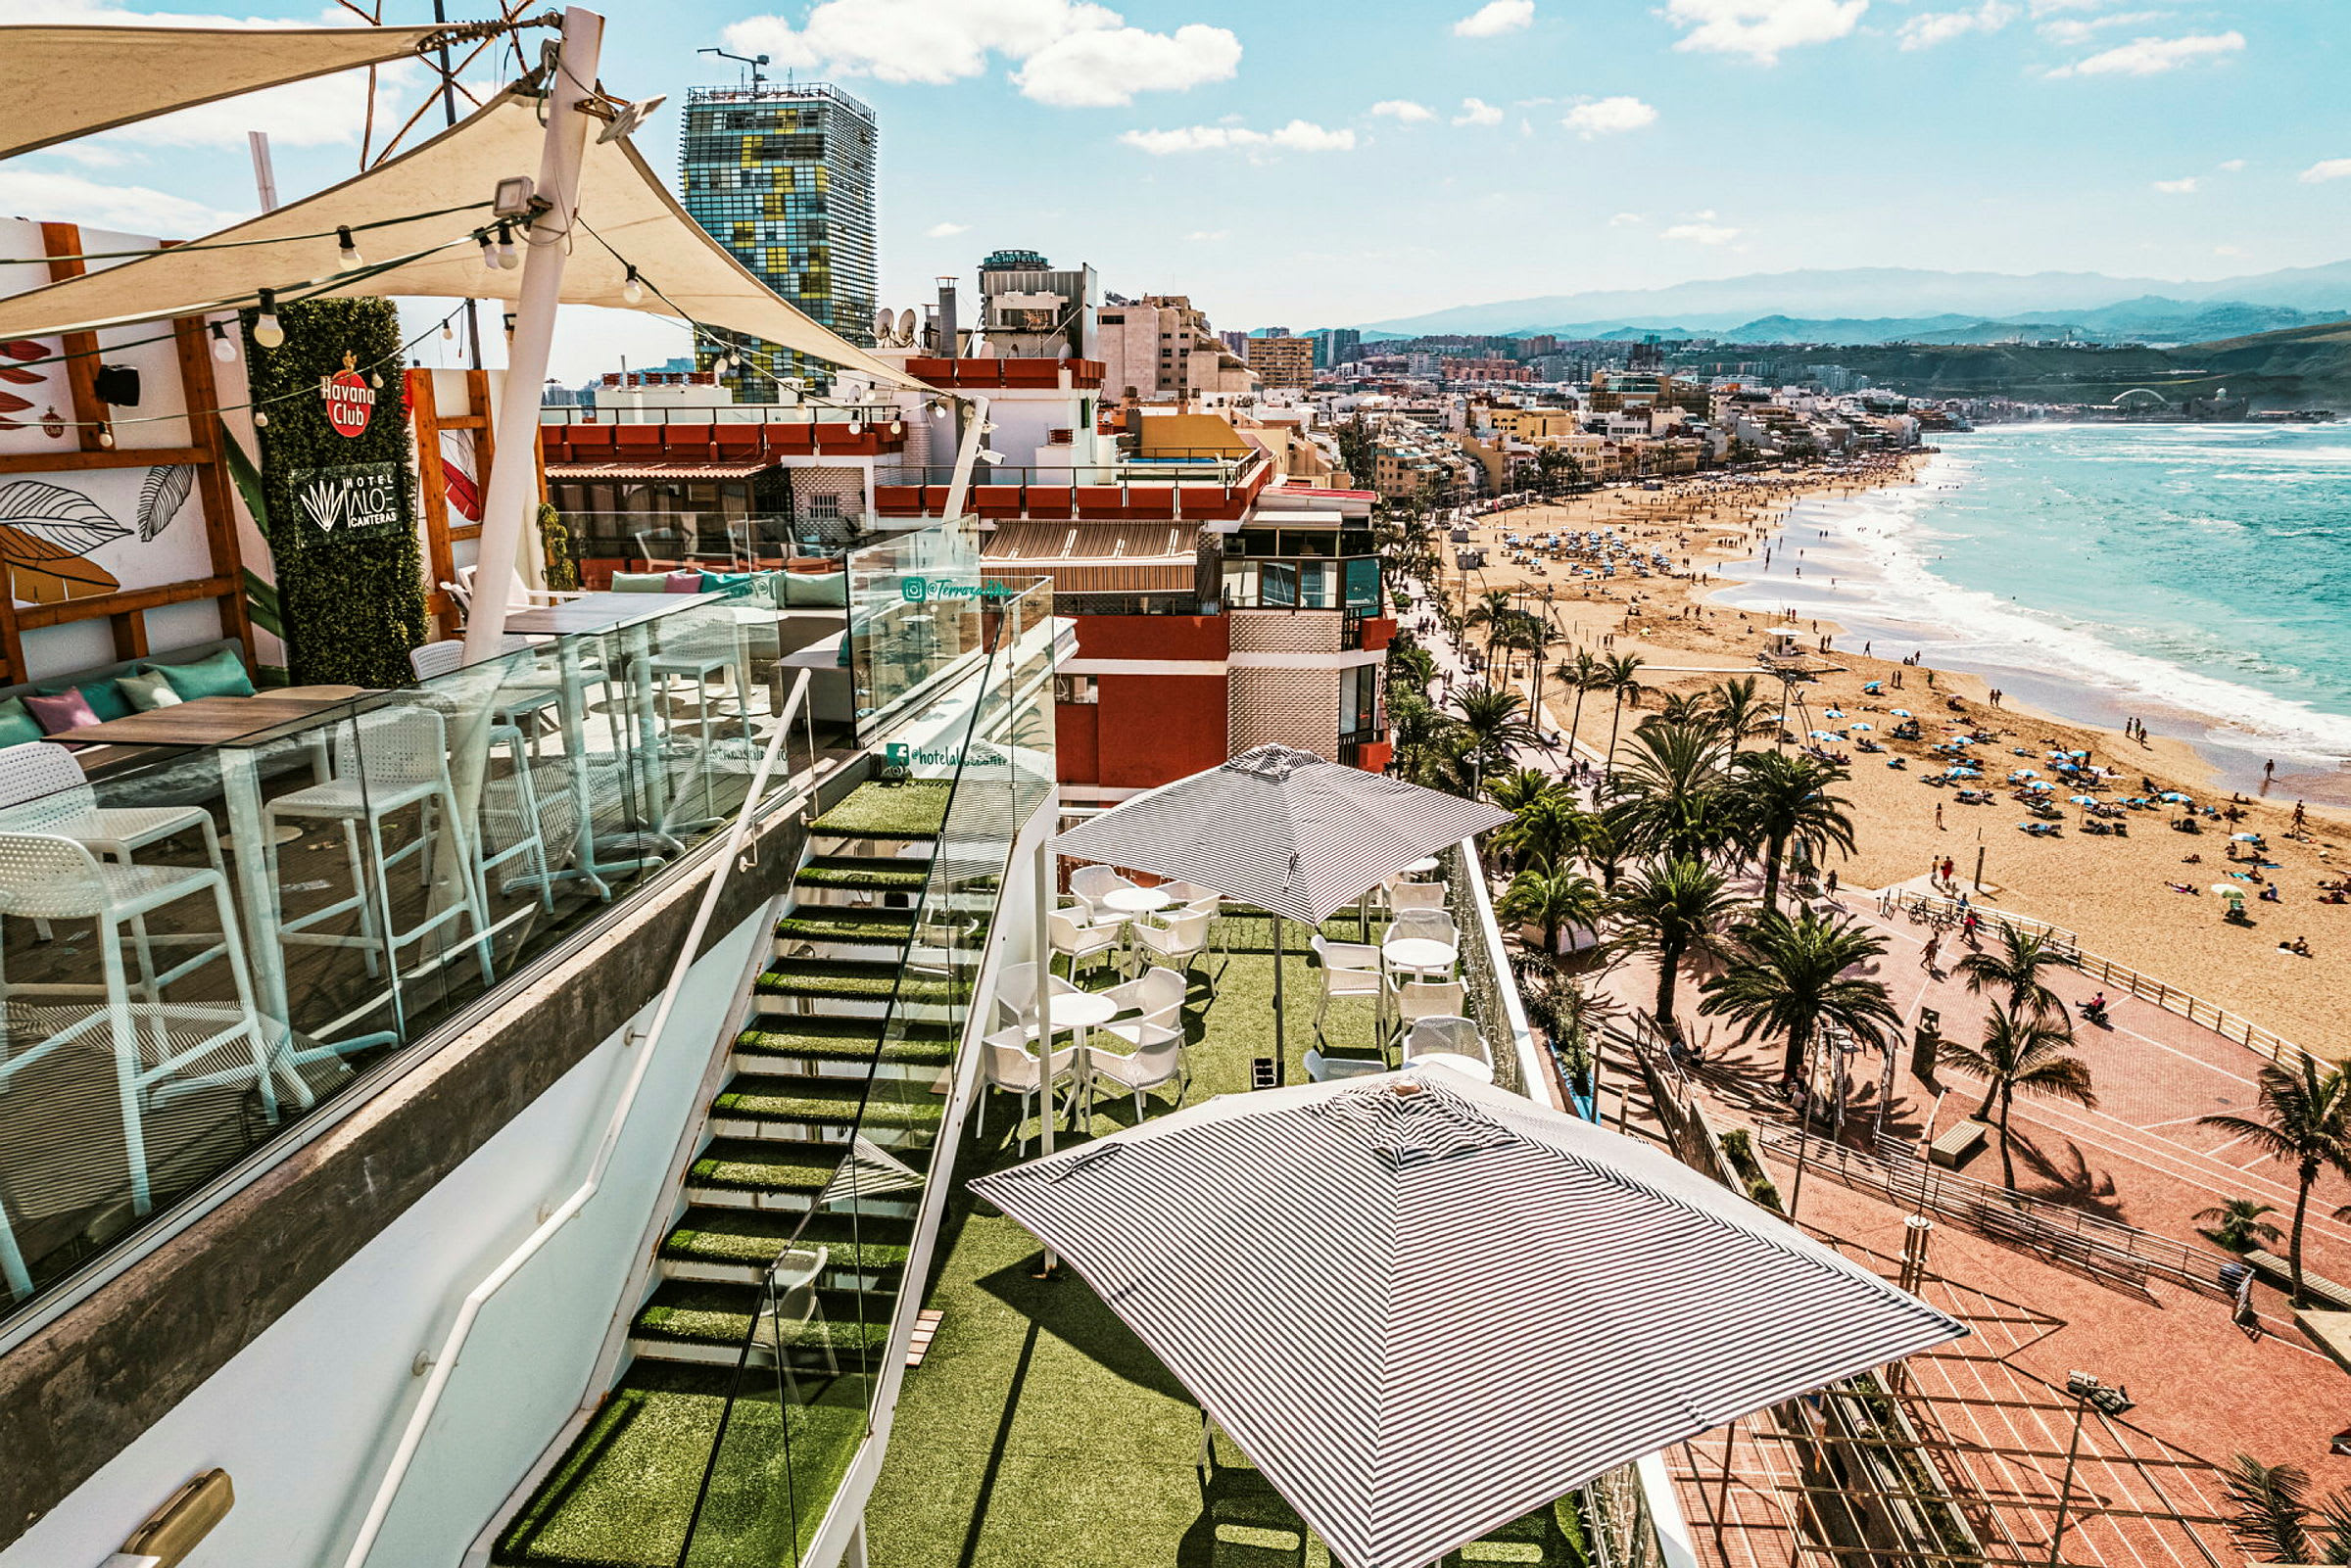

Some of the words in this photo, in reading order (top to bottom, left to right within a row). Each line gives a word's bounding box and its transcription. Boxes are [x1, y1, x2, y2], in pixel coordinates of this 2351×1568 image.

[320, 375, 377, 405] Havana
[333, 403, 364, 427] Club
[345, 475, 394, 489] HOTEL
[350, 486, 397, 517] ALOE
[350, 511, 398, 529] CANTERAS
